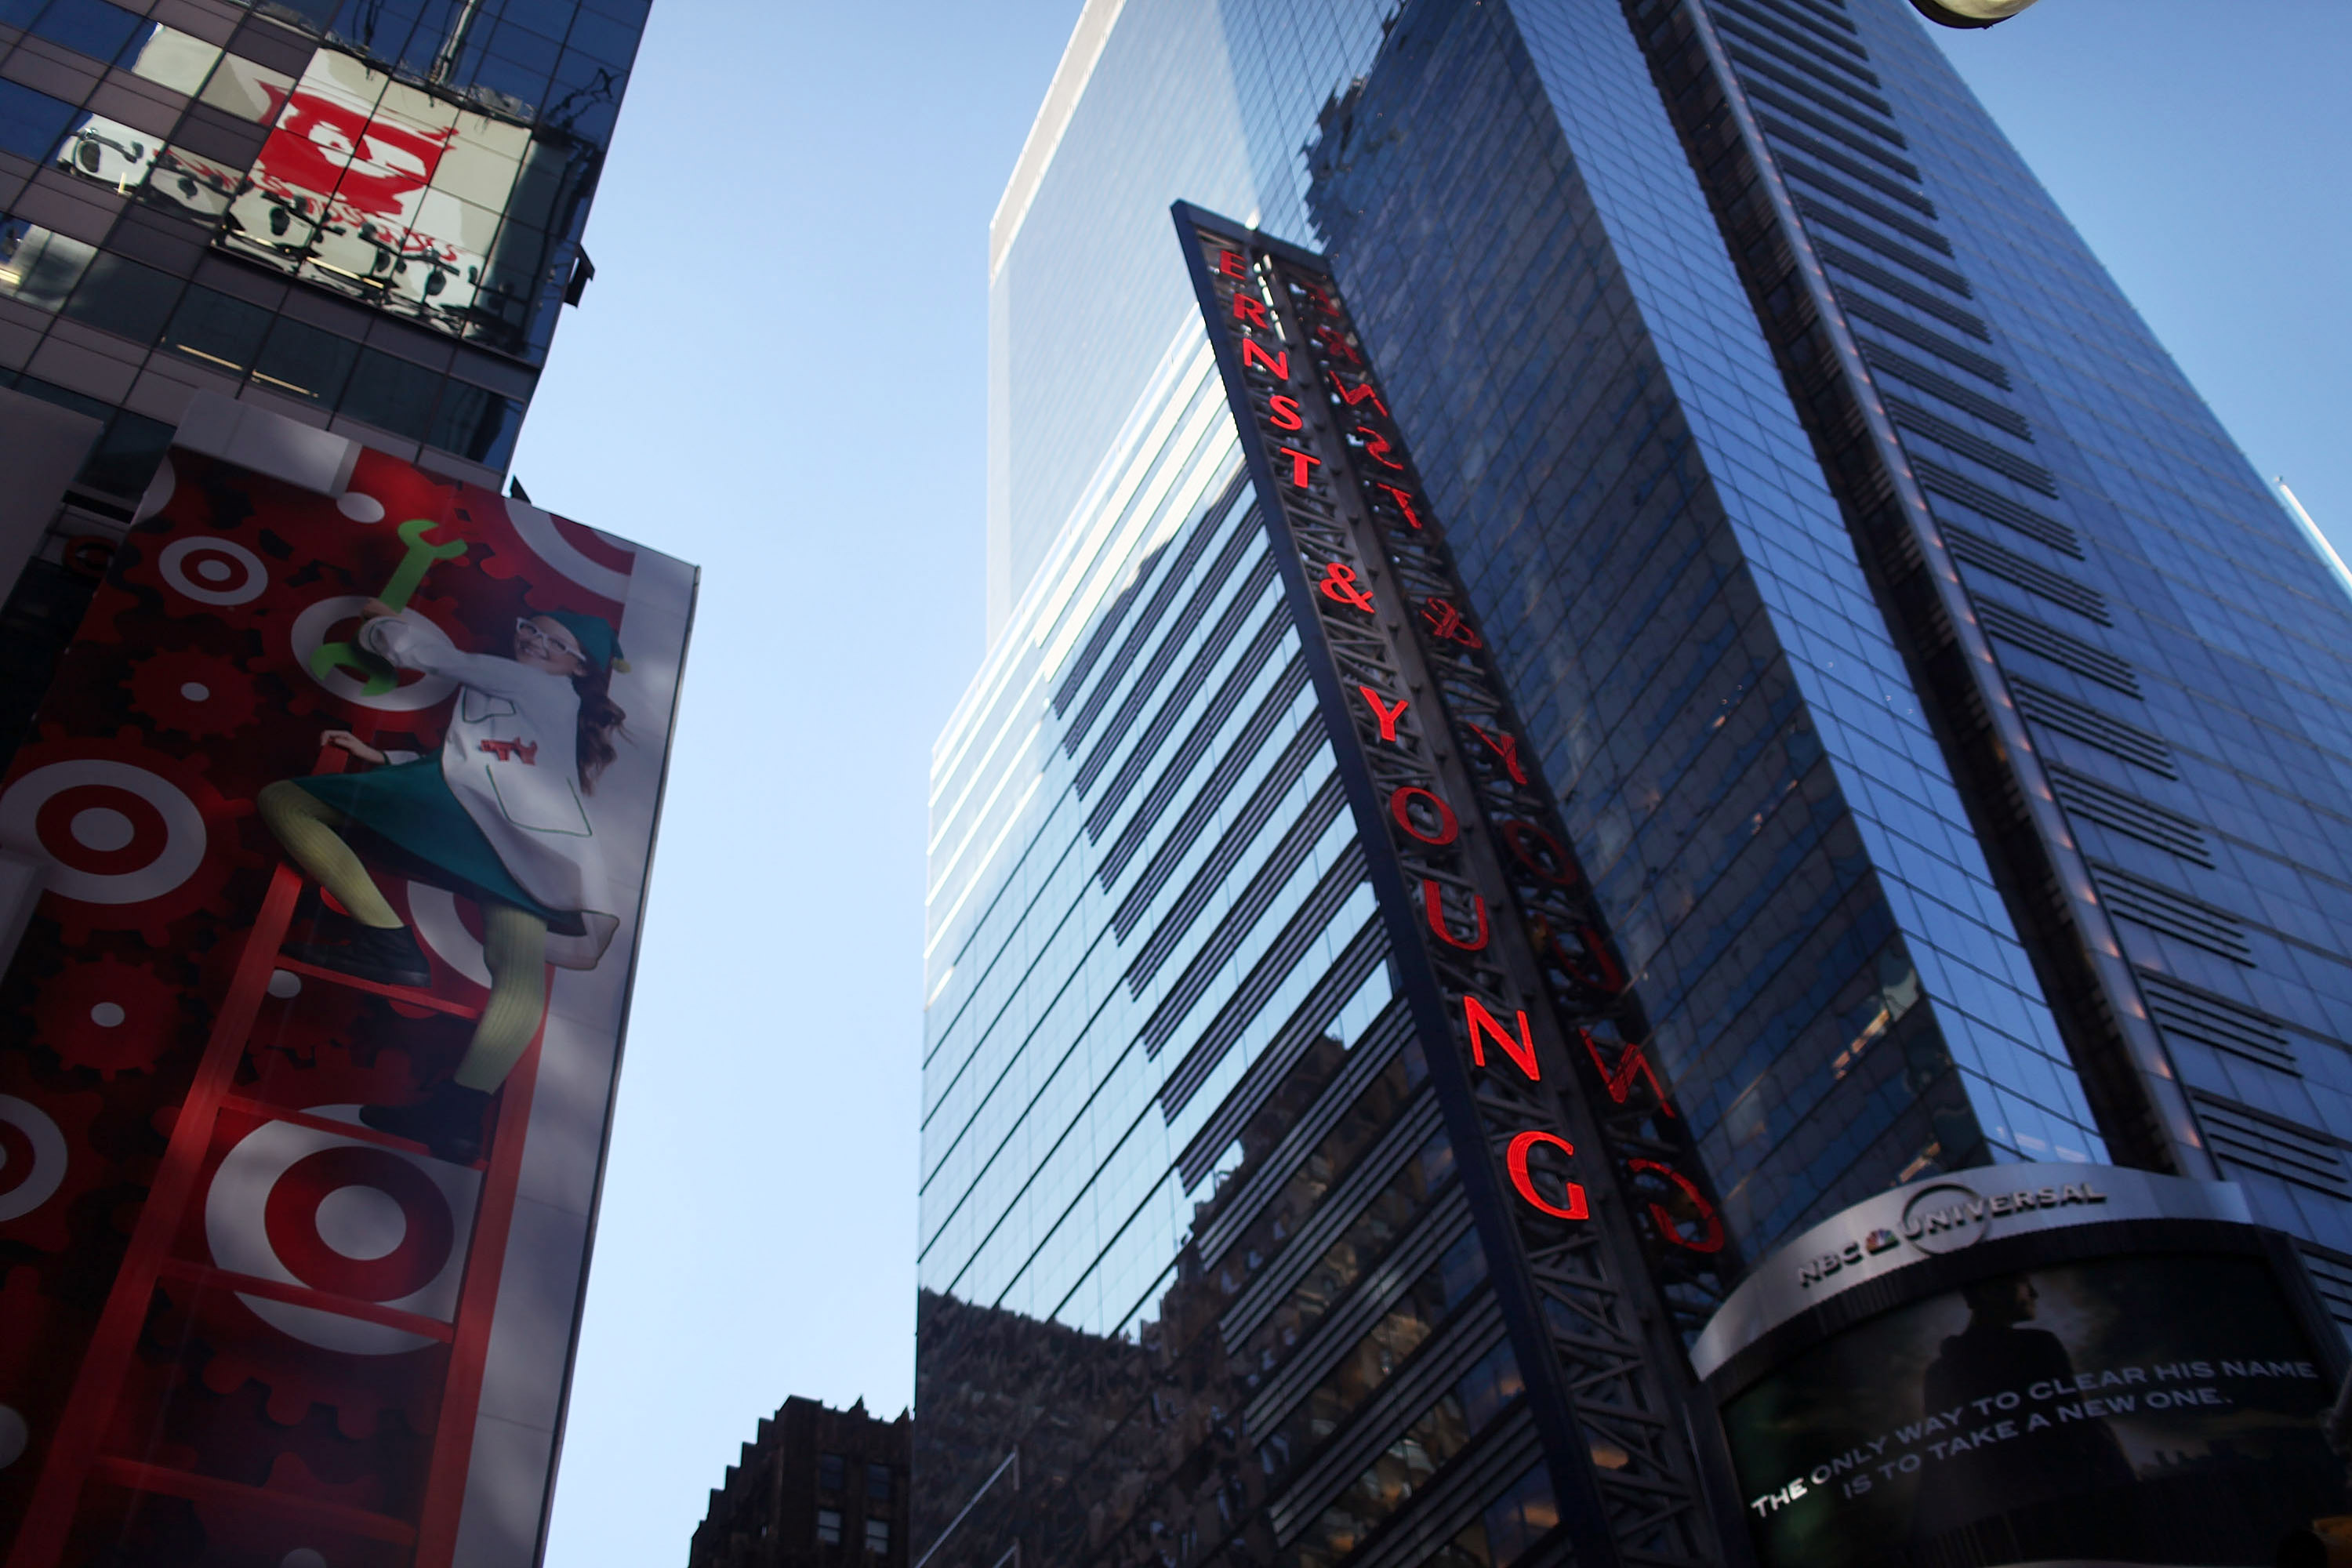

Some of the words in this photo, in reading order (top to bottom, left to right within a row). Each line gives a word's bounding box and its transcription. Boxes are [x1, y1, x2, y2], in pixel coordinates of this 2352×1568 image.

[1219, 250, 1320, 488] ERNST
[1319, 562, 1374, 615] &
[1359, 684, 1589, 1221] YOUNG
[1798, 1242, 1862, 1287] NBC
[1897, 1182, 2107, 1241] UNIVERSAL
[1750, 1478, 1807, 1517] THE
[1810, 1436, 1888, 1484] ONLY
[1895, 1406, 1963, 1444] WAY
[1972, 1392, 2020, 1415] TO
[2028, 1367, 2147, 1399] CLEAR
[2154, 1362, 2215, 1381] HIS
[2220, 1361, 2318, 1378] NAME
[1843, 1474, 1872, 1499] IS
[1878, 1454, 1920, 1479] TO
[1928, 1421, 2019, 1460] TAKE
[2027, 1413, 2051, 1432] A
[2057, 1395, 2136, 1423] NEW
[2144, 1388, 2234, 1409] ONE.
